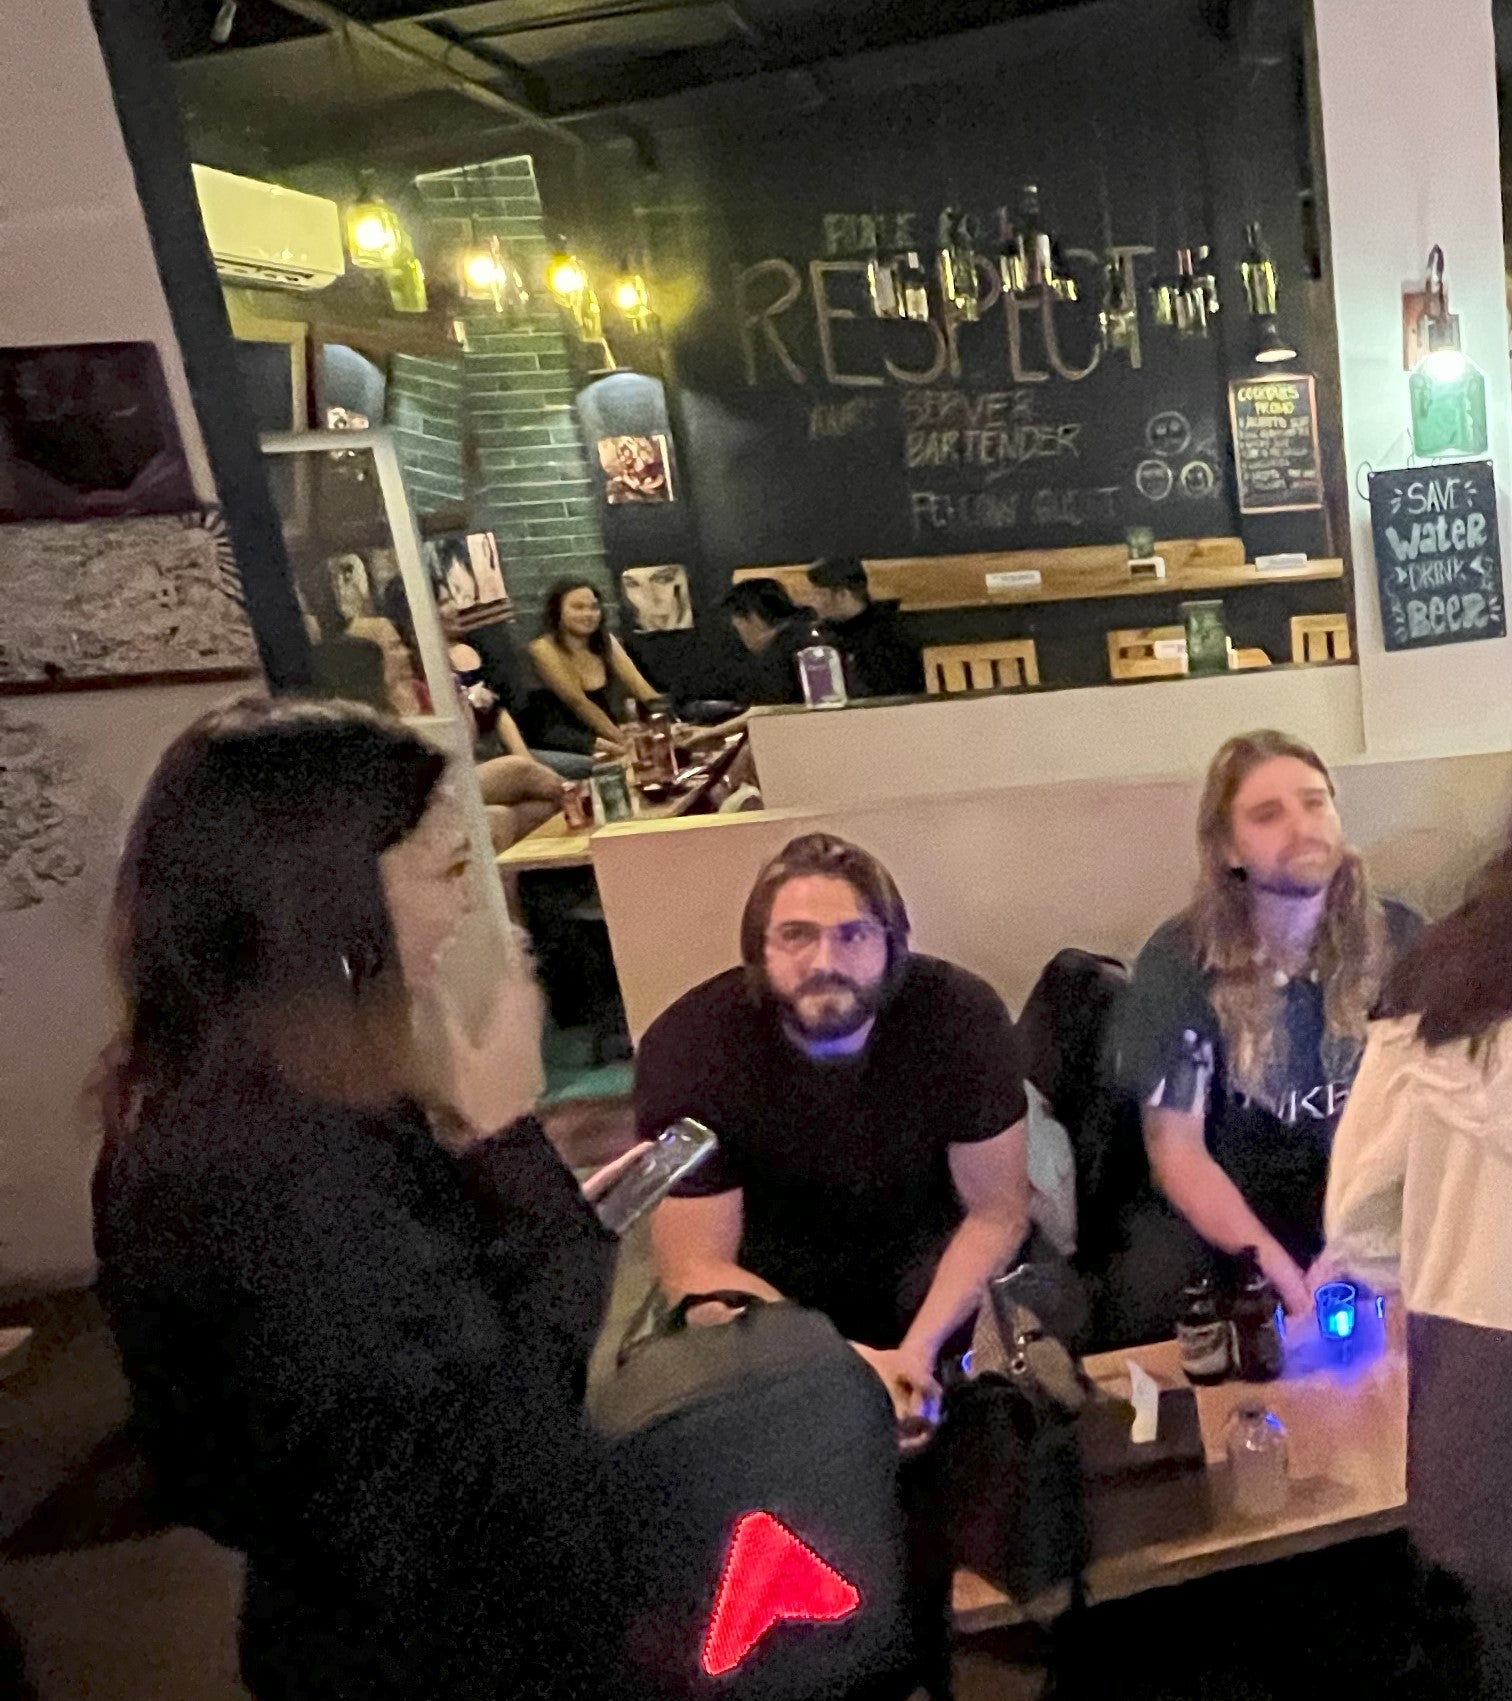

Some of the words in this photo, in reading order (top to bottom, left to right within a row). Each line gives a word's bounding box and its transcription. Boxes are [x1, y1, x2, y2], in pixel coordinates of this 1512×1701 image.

[735, 244, 1156, 387] RESPECT
[903, 389, 1036, 428] SERVER
[905, 423, 1082, 469] BARTENDER
[1406, 478, 1462, 515] SAVE
[1408, 555, 1464, 593] DRINK
